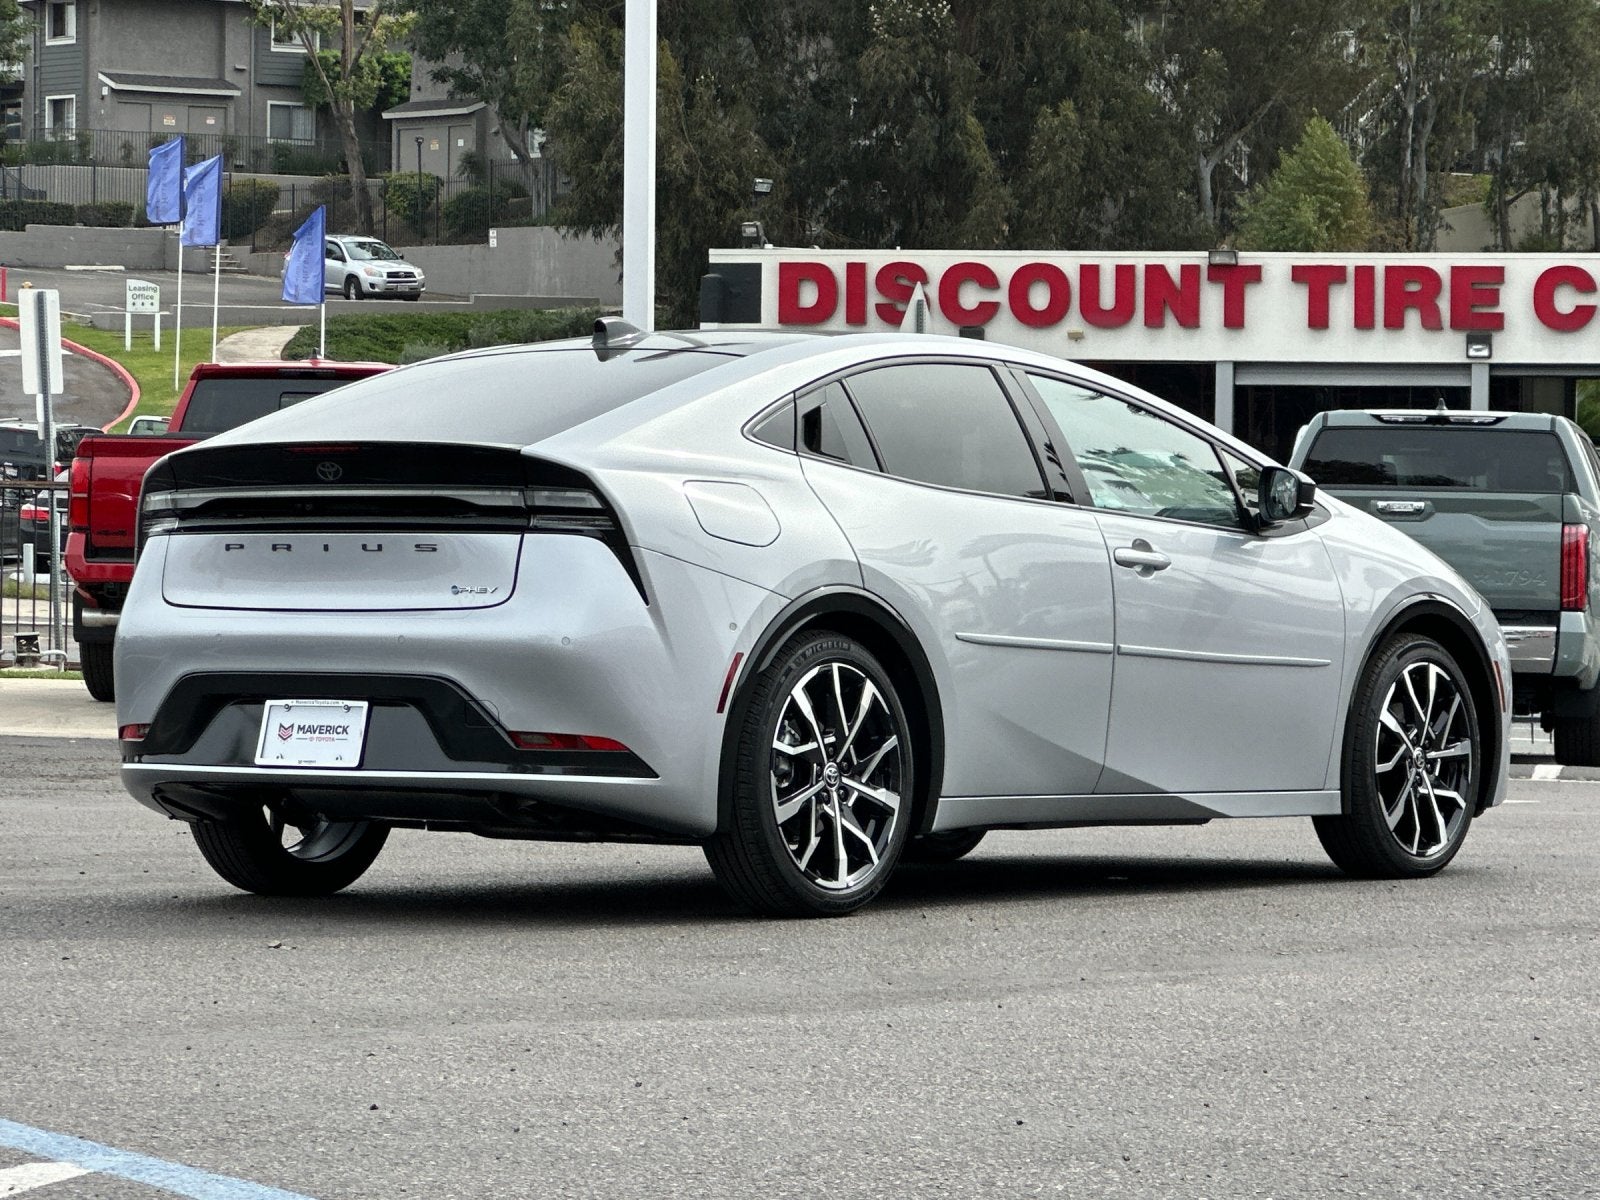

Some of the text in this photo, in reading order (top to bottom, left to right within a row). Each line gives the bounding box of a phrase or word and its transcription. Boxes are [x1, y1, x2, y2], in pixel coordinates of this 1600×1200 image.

[128, 284, 158, 293] Leasing
[778, 261, 1262, 329] DISCOUNT
[1291, 265, 1505, 331] TIRE
[225, 543, 438, 552] PRIUS
[459, 586, 499, 594] PHEV
[805, 641, 850, 657] MICHELIN
[297, 724, 349, 735] MAVERICK
